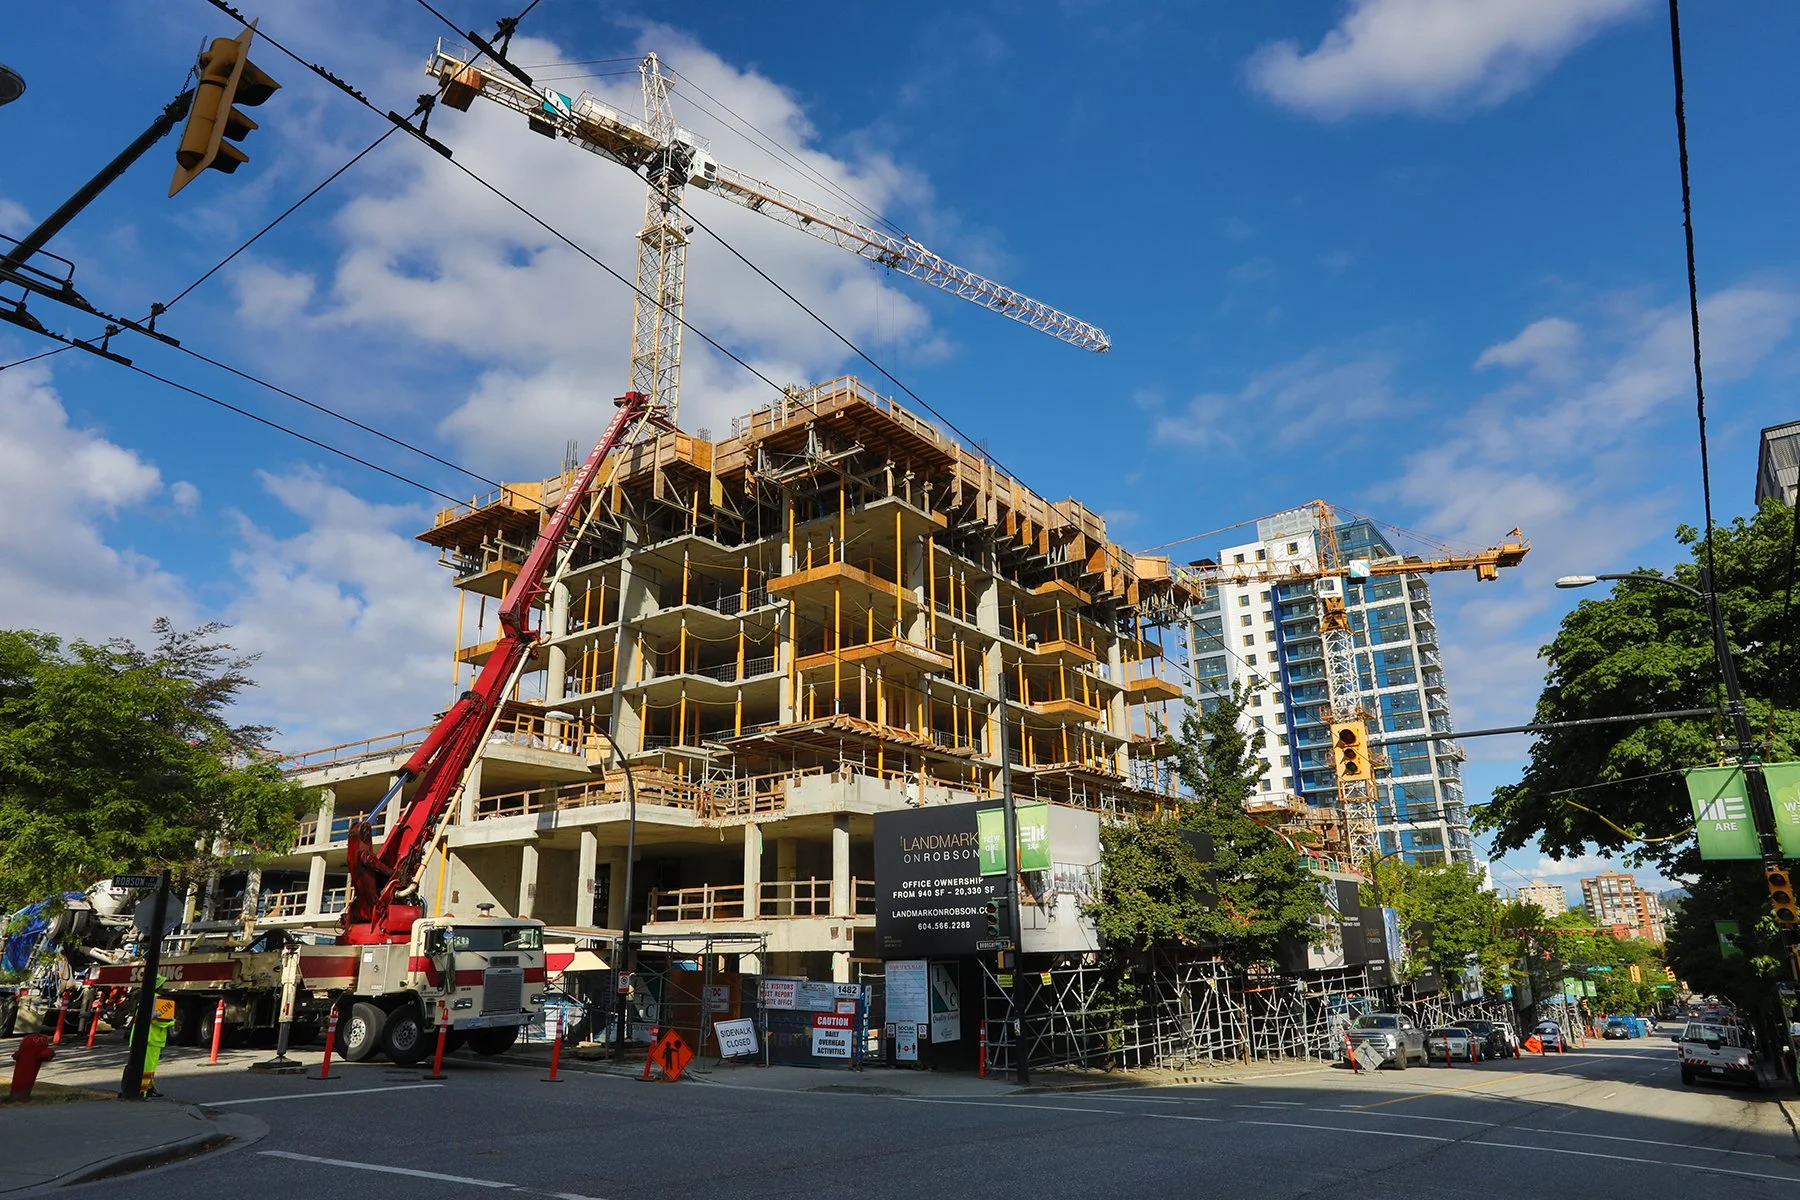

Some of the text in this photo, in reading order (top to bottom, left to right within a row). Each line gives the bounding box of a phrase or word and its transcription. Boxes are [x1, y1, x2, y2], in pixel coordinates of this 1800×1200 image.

[551, 406, 628, 525] REYNOLDS CONCRETE
[1715, 822, 1738, 831] ARE
[903, 832, 980, 852] LANDMARK
[115, 877, 146, 886] ROBSON
[902, 877, 984, 889] OFFICE OWNERSHIP
[892, 890, 916, 899] FROM
[918, 889, 932, 898] 940
[934, 888, 945, 897] SF
[954, 887, 982, 896] 20,330
[984, 886, 995, 894] SF
[917, 921, 971, 931] 604.566.2288
[130, 966, 183, 982] SCING
[837, 986, 857, 994] 1482
[817, 1016, 849, 1027] CAUTION
[720, 1027, 752, 1038] SIDEWALK
[824, 1030, 840, 1038] DAILY
[726, 1038, 751, 1048] CLOSED
[818, 1039, 846, 1047] OVERHEAD
[817, 1047, 846, 1056] ACTIVITIES
